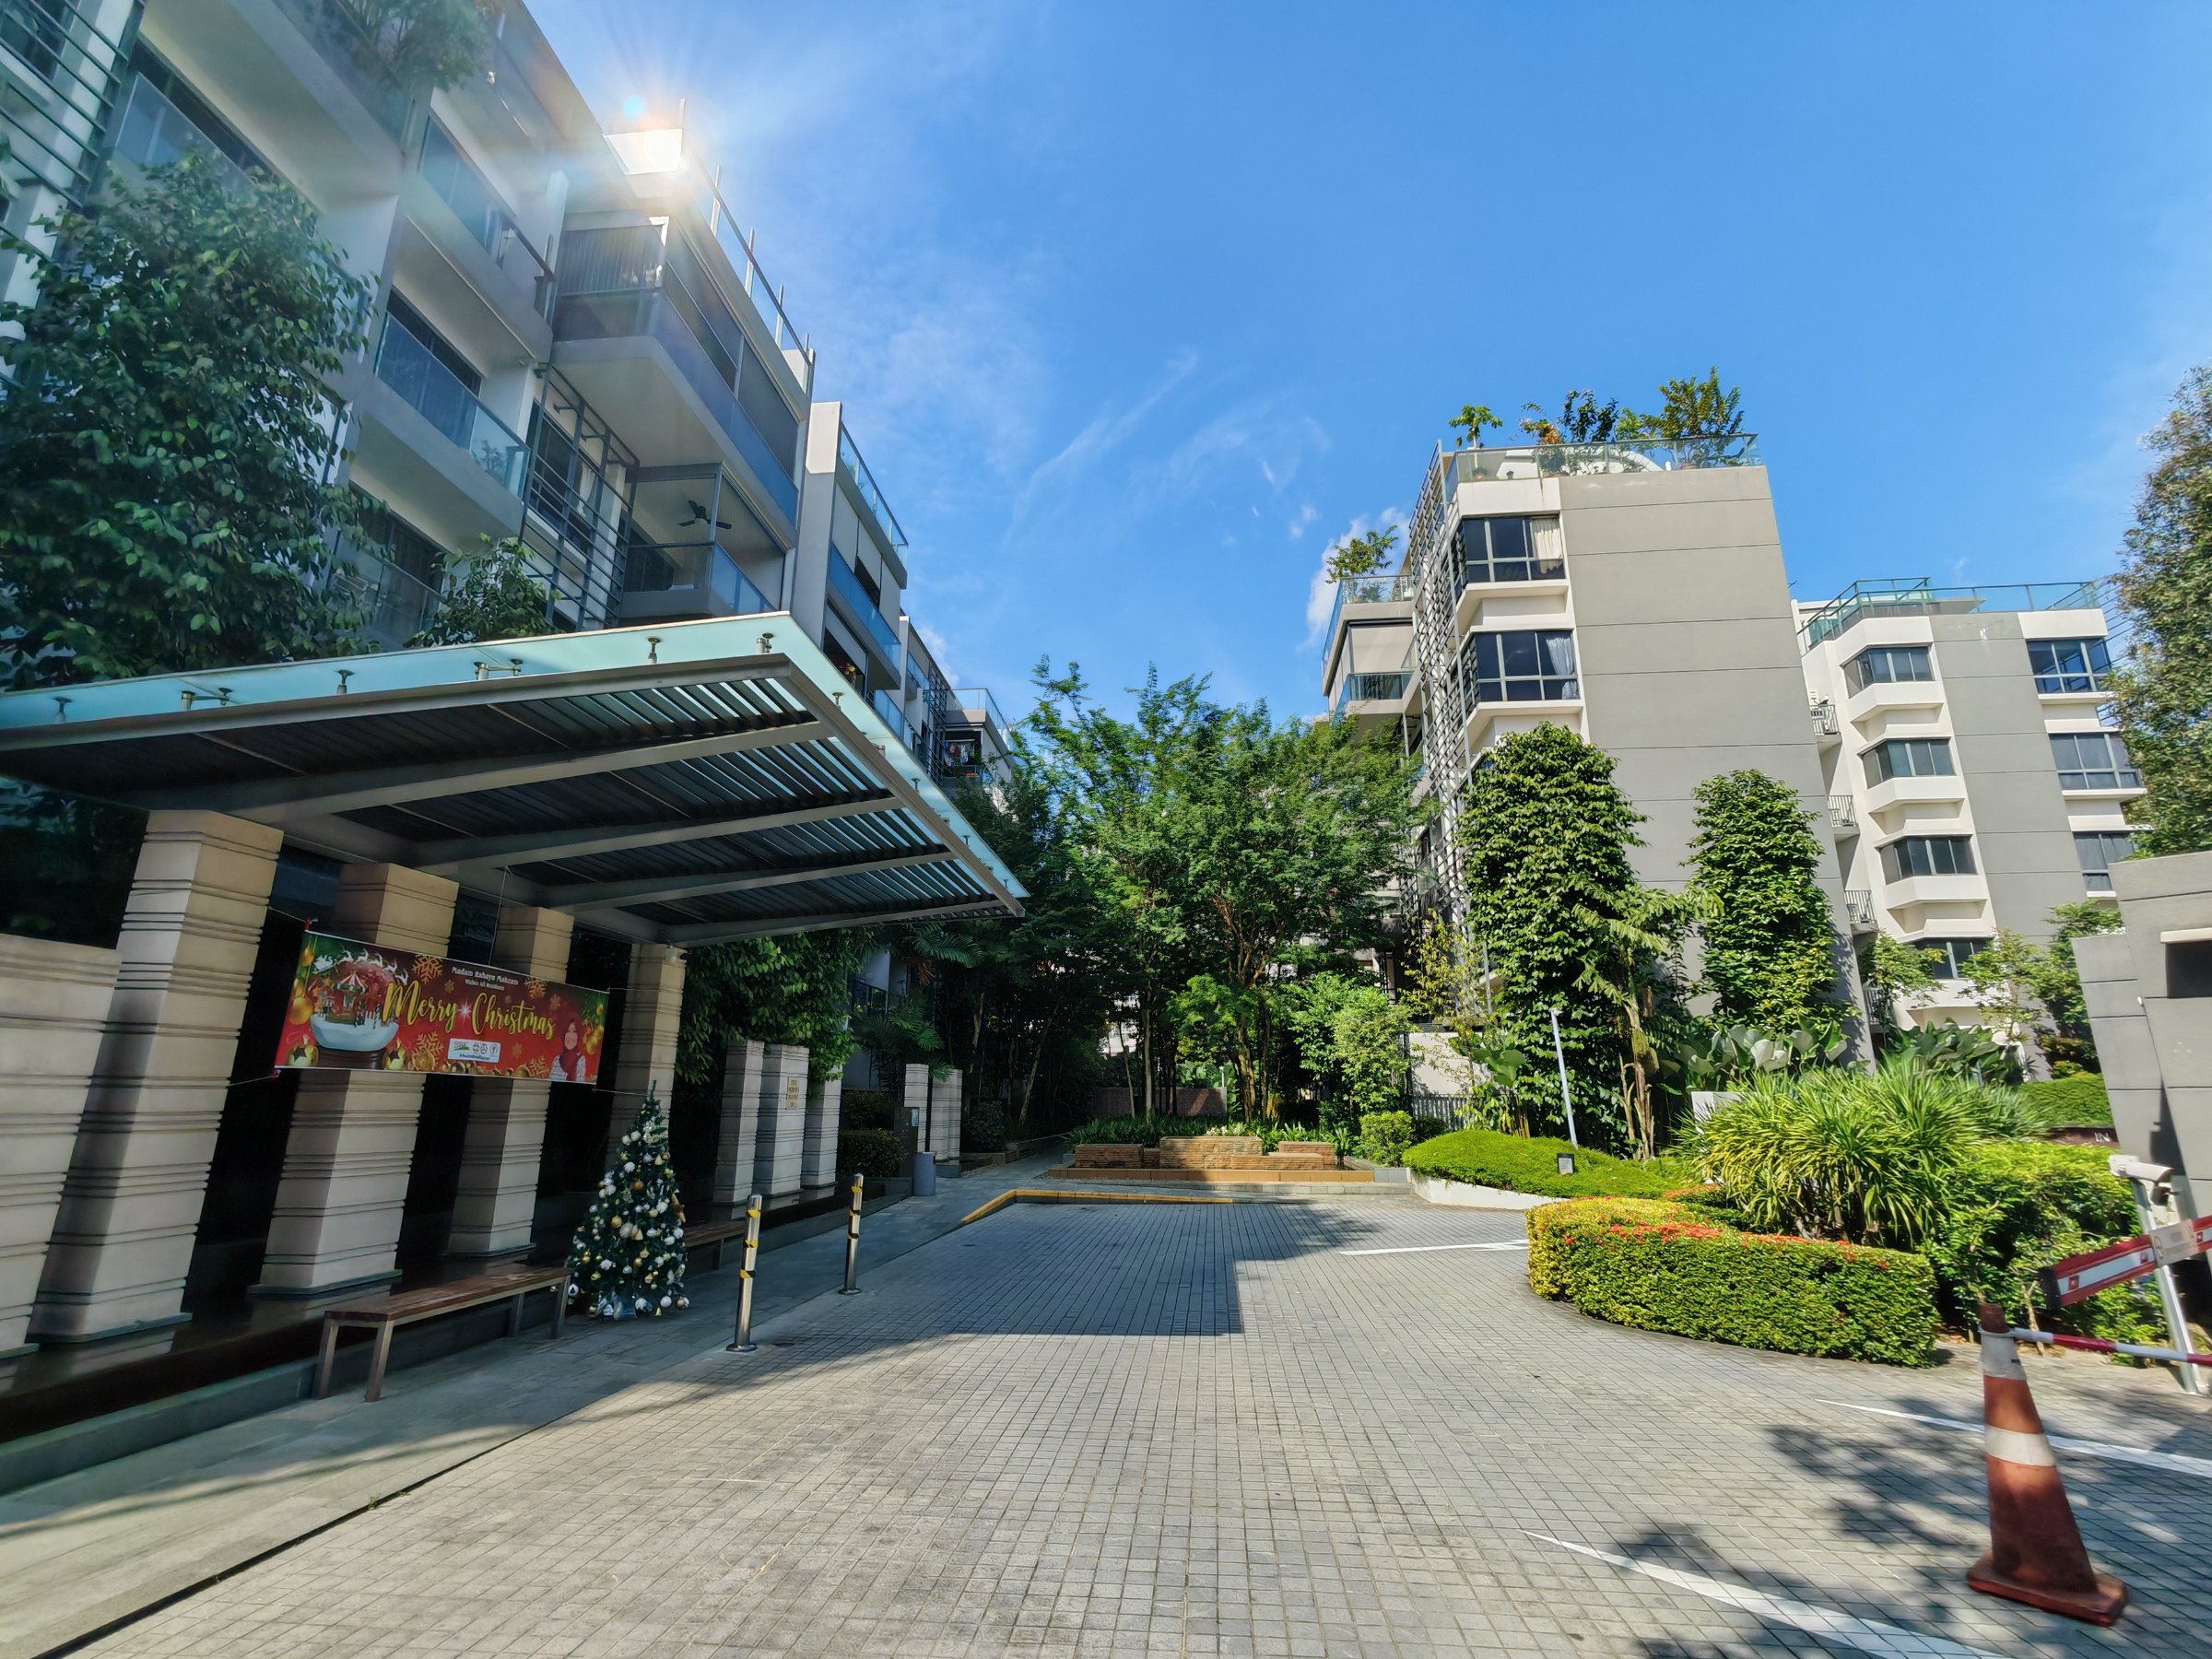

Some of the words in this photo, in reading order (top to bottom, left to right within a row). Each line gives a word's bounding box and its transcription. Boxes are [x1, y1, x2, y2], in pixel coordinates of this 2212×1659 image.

[452, 966, 474, 977] Madam
[382, 980, 459, 1034] Merry
[471, 992, 555, 1041] Christmas
